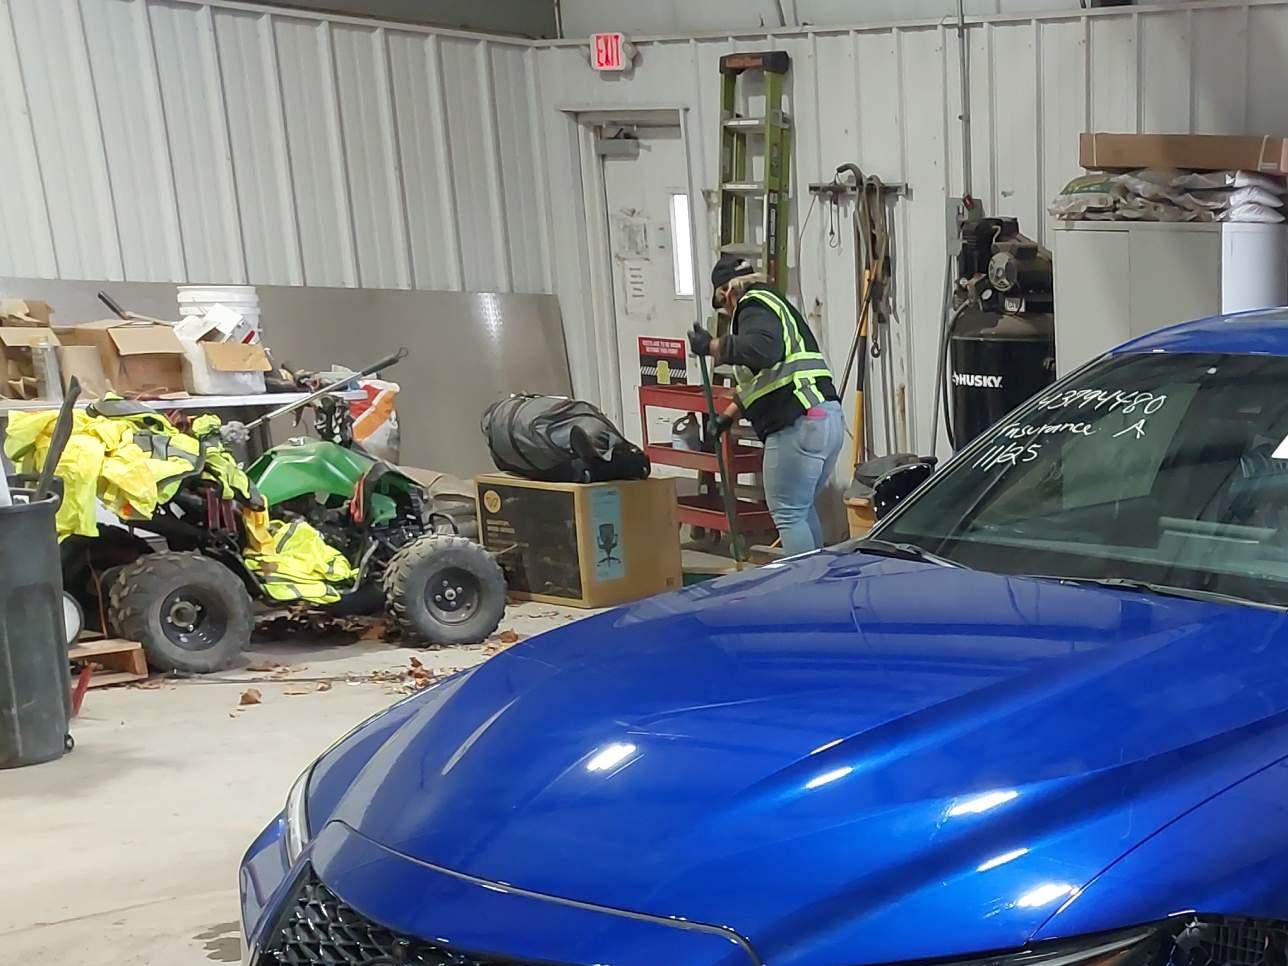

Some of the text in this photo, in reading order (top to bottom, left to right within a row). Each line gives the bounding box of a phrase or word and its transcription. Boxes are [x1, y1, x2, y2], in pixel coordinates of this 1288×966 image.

[595, 35, 620, 67] EXIT
[959, 373, 1003, 388] HUSKY
[997, 421, 1097, 440] Insurance
